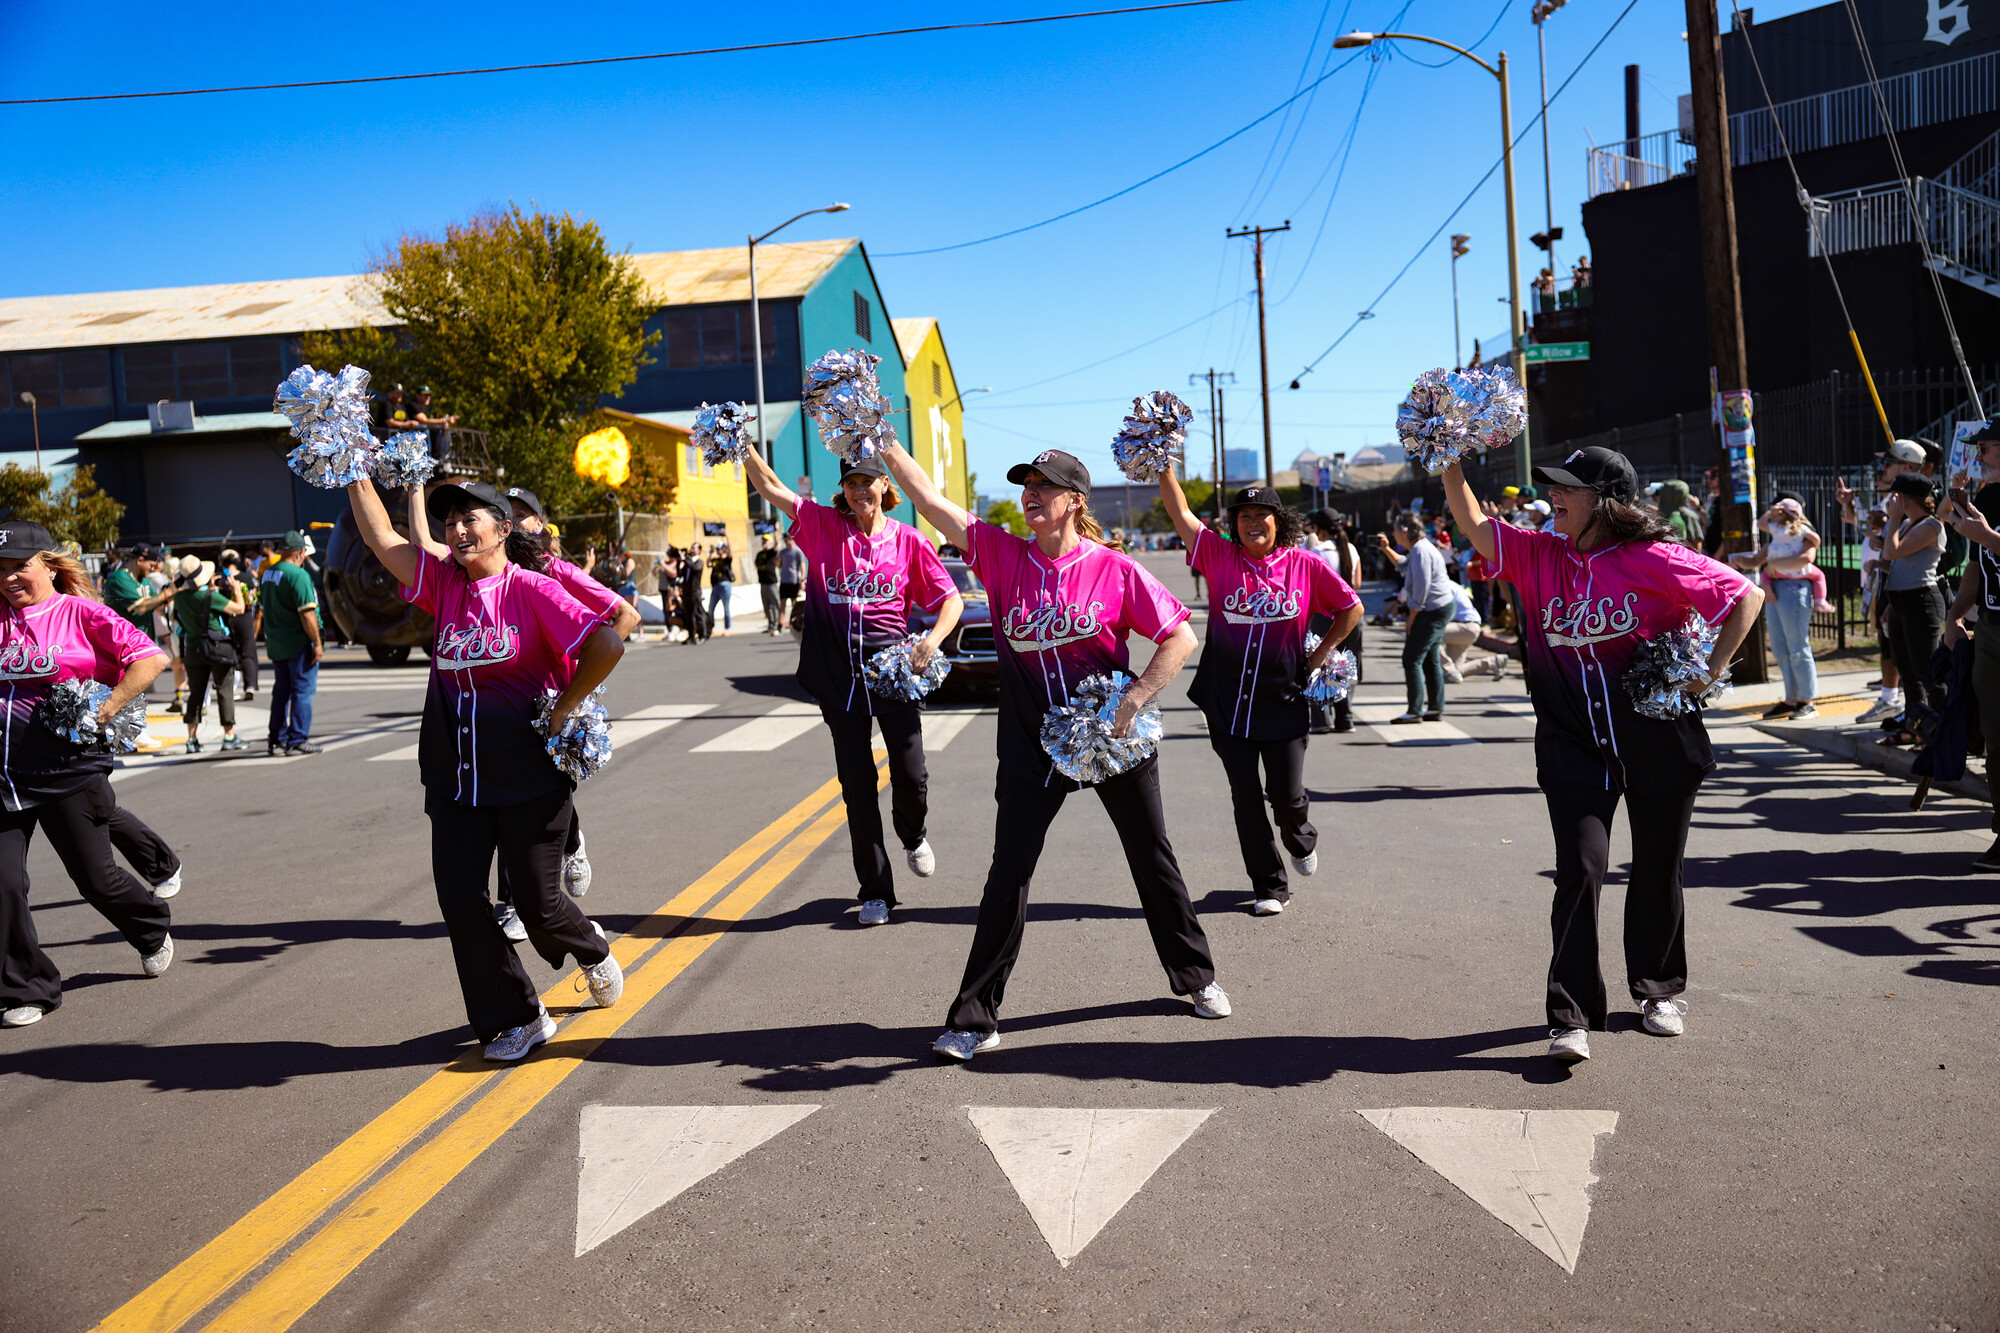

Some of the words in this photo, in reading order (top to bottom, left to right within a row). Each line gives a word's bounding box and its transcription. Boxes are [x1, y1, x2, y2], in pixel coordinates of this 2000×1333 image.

[826, 568, 902, 599] SASS
[1224, 586, 1302, 618] SASS
[1540, 591, 1639, 637] SASS
[1002, 600, 1104, 641] SASS
[0, 643, 64, 674] ASS
